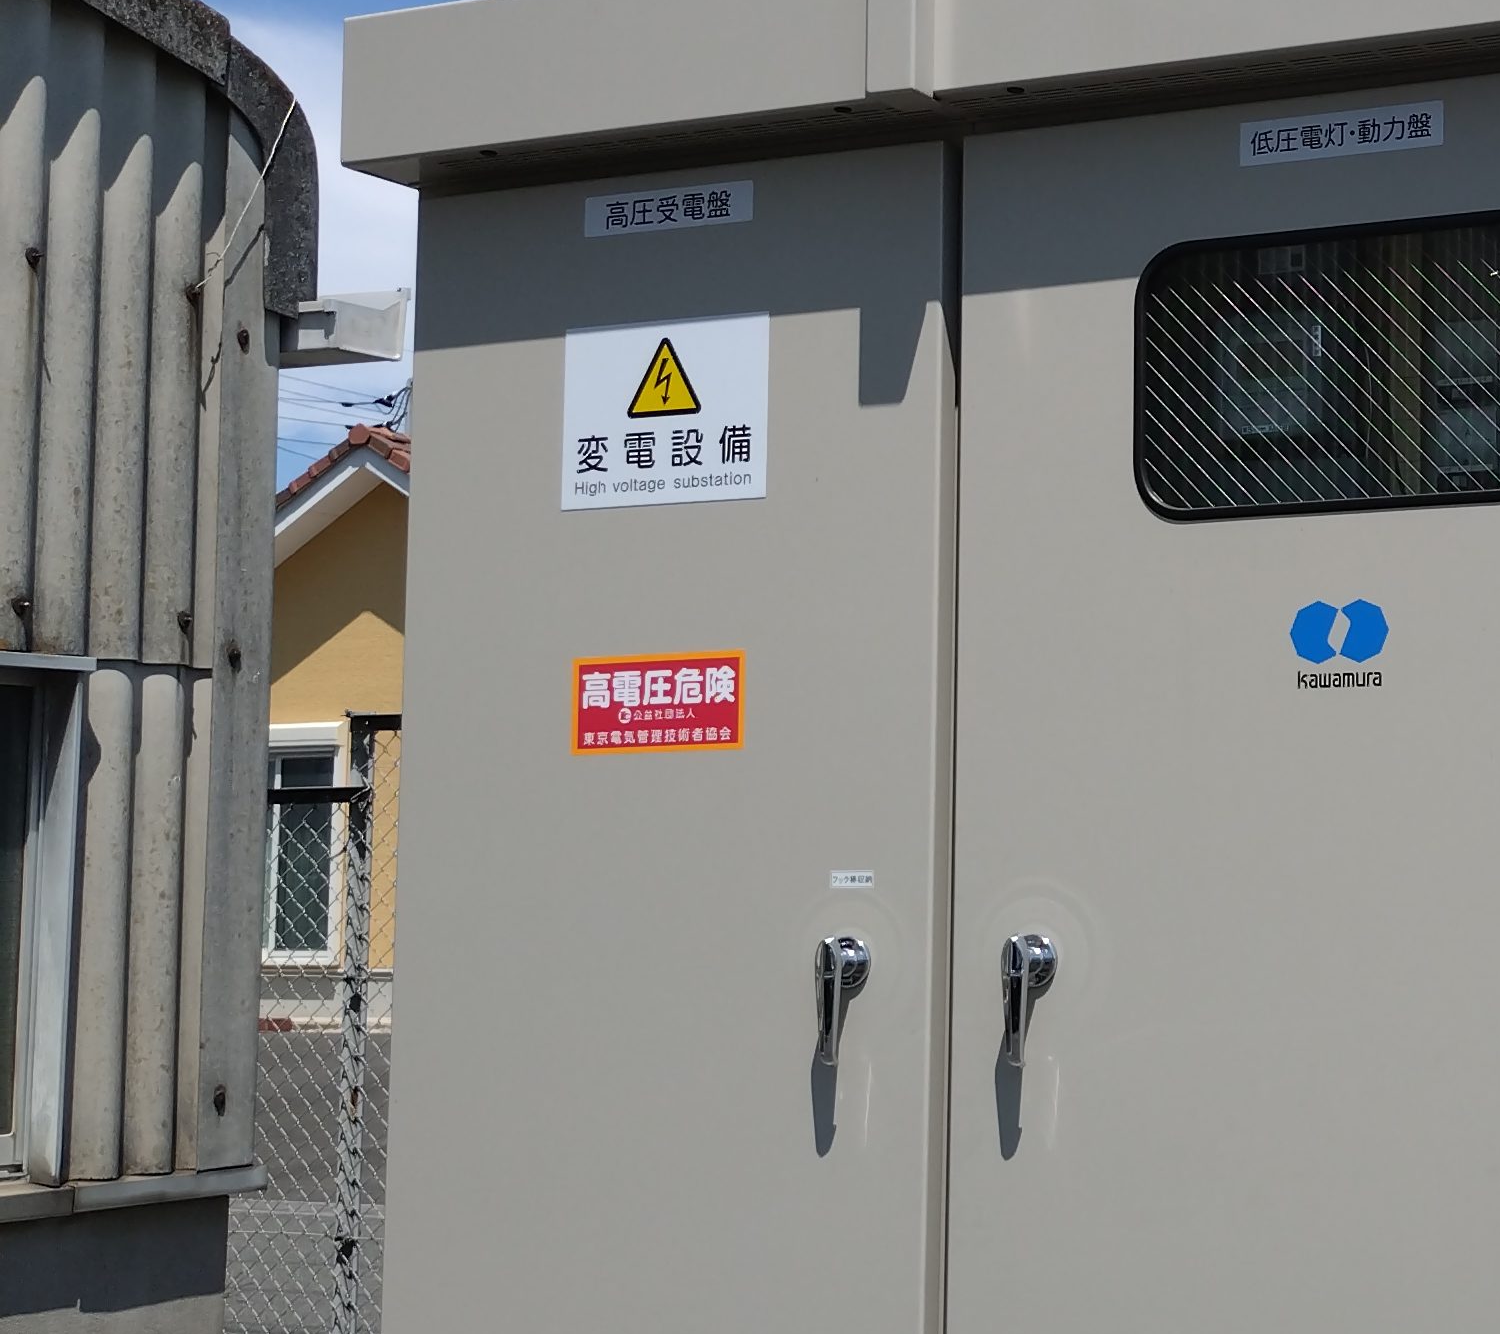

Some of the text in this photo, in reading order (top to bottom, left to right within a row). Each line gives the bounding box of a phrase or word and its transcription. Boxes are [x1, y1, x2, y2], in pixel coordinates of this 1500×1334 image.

[605, 189, 732, 230] 高圧受電盤
[576, 424, 752, 474] 変電設備
[574, 471, 752, 497] High voltage substation
[582, 665, 736, 709] 高電圧危険
[1297, 670, 1382, 689] kawamura
[583, 726, 732, 746] 東京電気管理技術者協会
